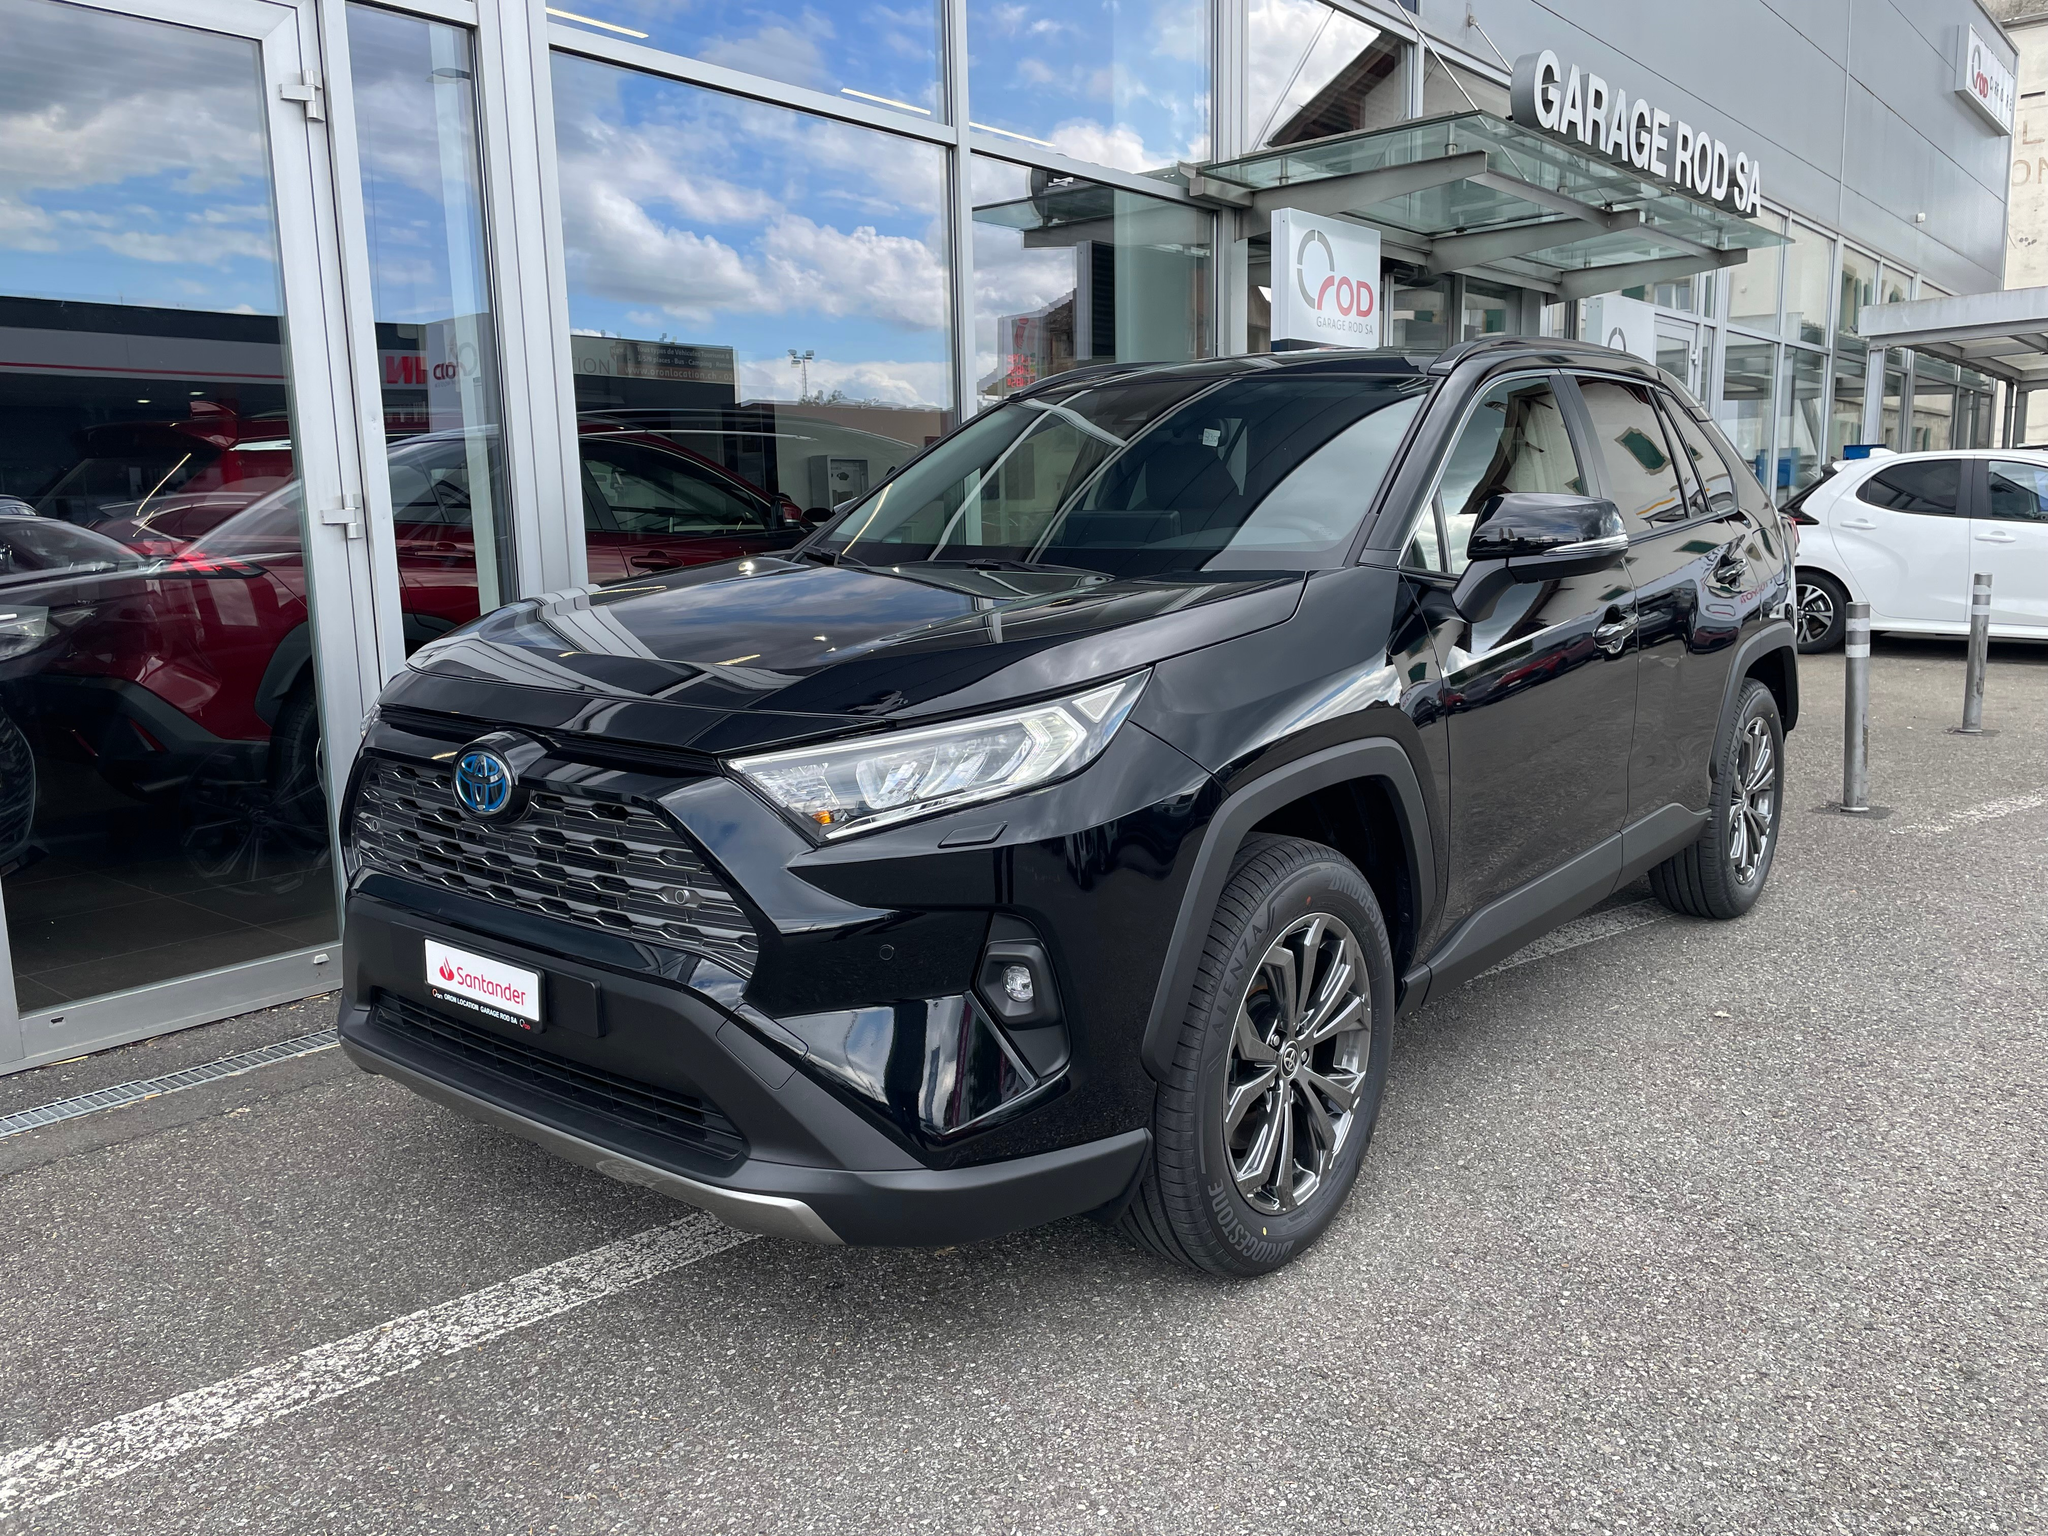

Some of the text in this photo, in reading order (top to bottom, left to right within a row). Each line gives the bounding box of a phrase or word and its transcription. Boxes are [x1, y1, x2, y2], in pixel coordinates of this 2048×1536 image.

[1533, 49, 1762, 218] GARAGE ROD SA
[1316, 316, 1374, 335] GARAGE ROD SA
[624, 366, 717, 381] www.oronlocation.ch
[1328, 866, 1391, 968] BRIDGESTONE
[456, 966, 526, 1006] Santander
[457, 995, 480, 1012] LOCATION
[480, 1005, 500, 1019] GARAGE
[499, 1013, 511, 1022] ROD
[510, 1016, 518, 1025] SA
[1211, 923, 1263, 1037] ALENZA
[1207, 1178, 1295, 1263] BRIDGESTONE
